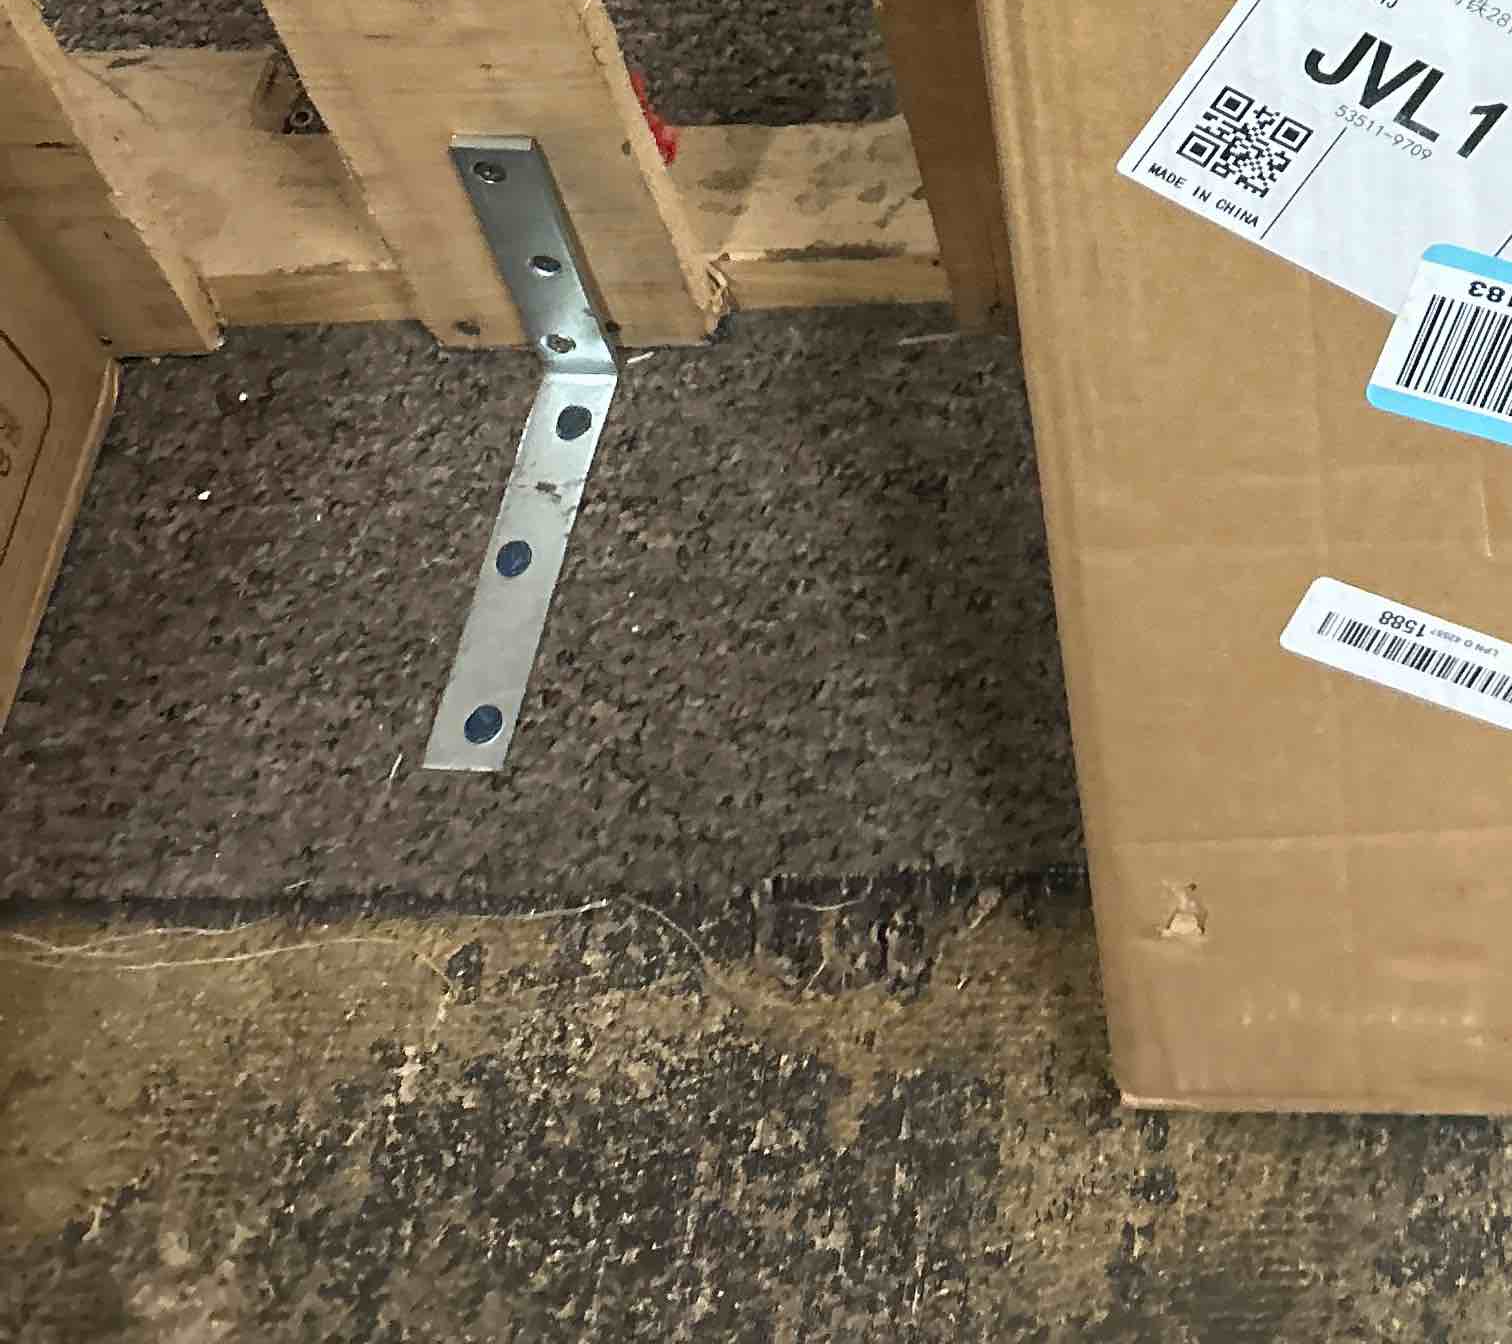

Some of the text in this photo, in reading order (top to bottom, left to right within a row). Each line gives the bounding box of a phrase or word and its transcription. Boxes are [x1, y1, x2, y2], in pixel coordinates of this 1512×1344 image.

[1334, 103, 1434, 161] 53511-9709
[1147, 161, 1260, 228] MADE IN CHINA
[1378, 610, 1427, 638] 1588
